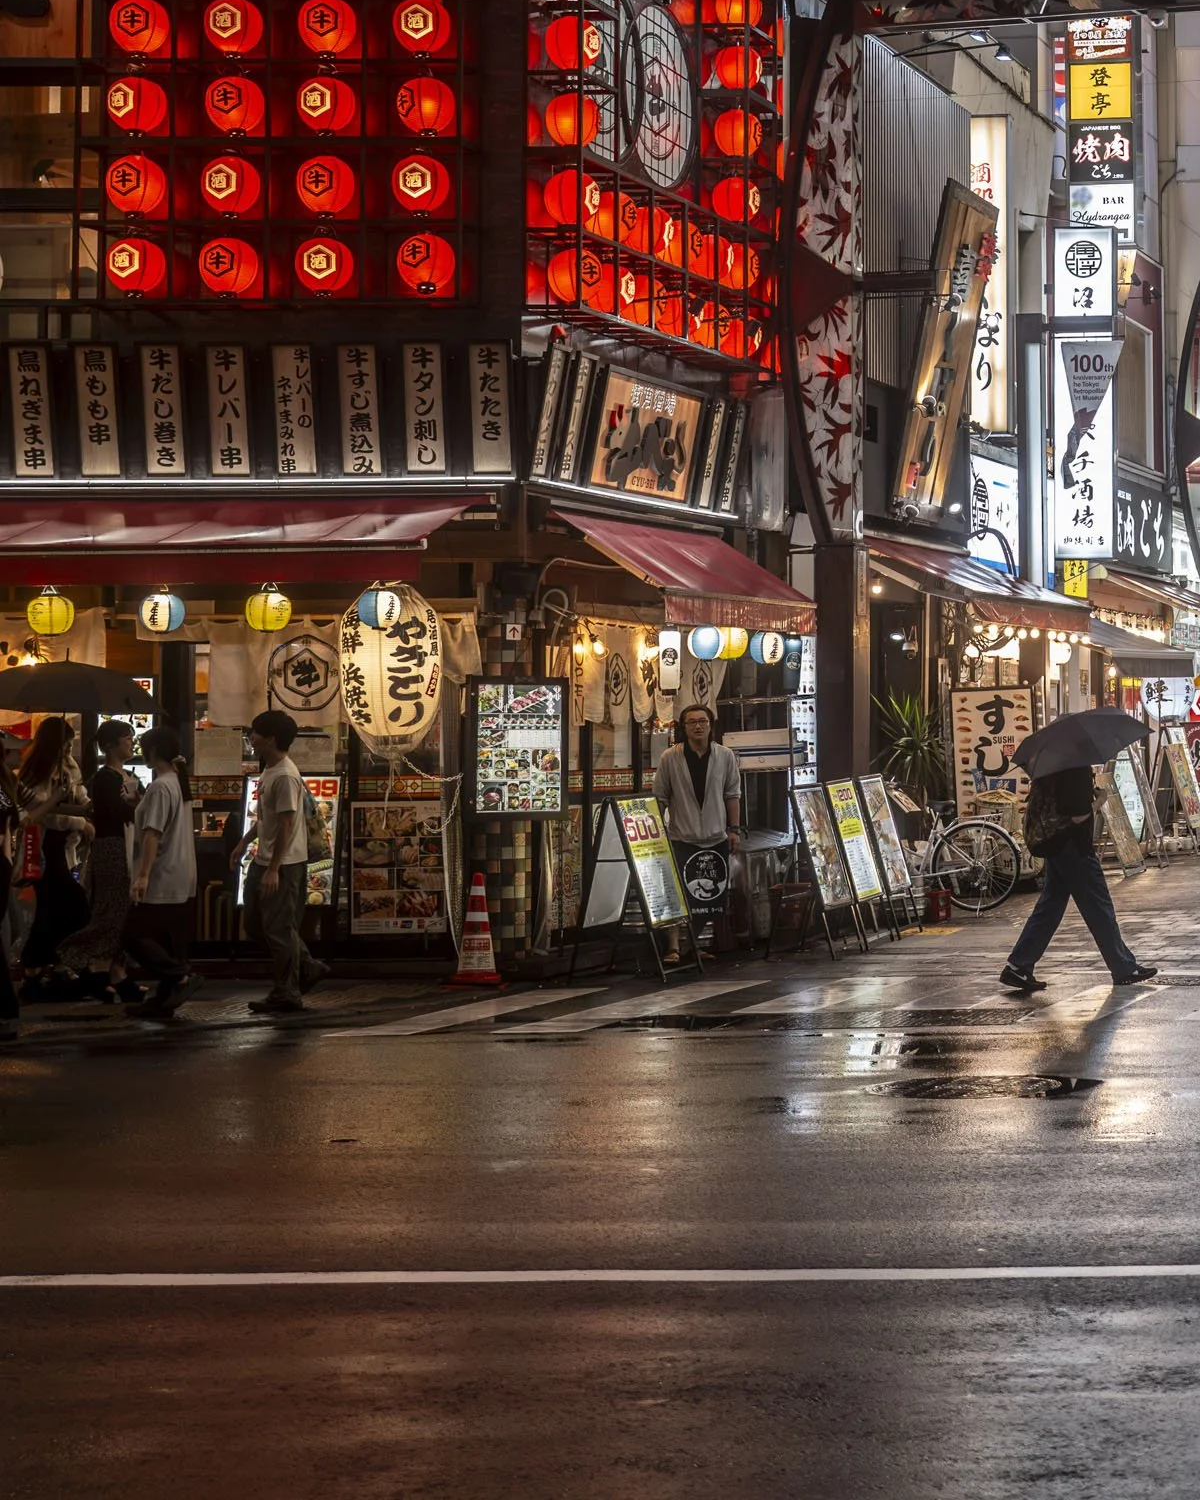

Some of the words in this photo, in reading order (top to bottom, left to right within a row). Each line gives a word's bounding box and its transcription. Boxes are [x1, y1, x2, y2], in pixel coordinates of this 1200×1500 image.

[1089, 66, 1112, 116] 登亭
[1071, 132, 1131, 164] 焼肉
[1090, 164, 1112, 179] ごち
[1072, 210, 1131, 225] Hydrangea
[1102, 195, 1125, 205] BAR
[83, 349, 111, 446] 鳥もも串
[148, 348, 177, 467] 牛だし巻き
[293, 347, 312, 429] 牛レバーの
[410, 346, 438, 465] 牛タン刺し
[476, 346, 503, 442] 牛たたき
[1070, 354, 1114, 373] 100th
[15, 349, 47, 471] 鳥ねぎま串
[213, 349, 244, 469] 牛レバー串
[345, 347, 375, 474] 牛すじ煮込み
[561, 360, 590, 473] 牛ロース串
[385, 616, 429, 728] やきとり
[973, 693, 1015, 777] すし
[992, 735, 1015, 745] SUSHI
